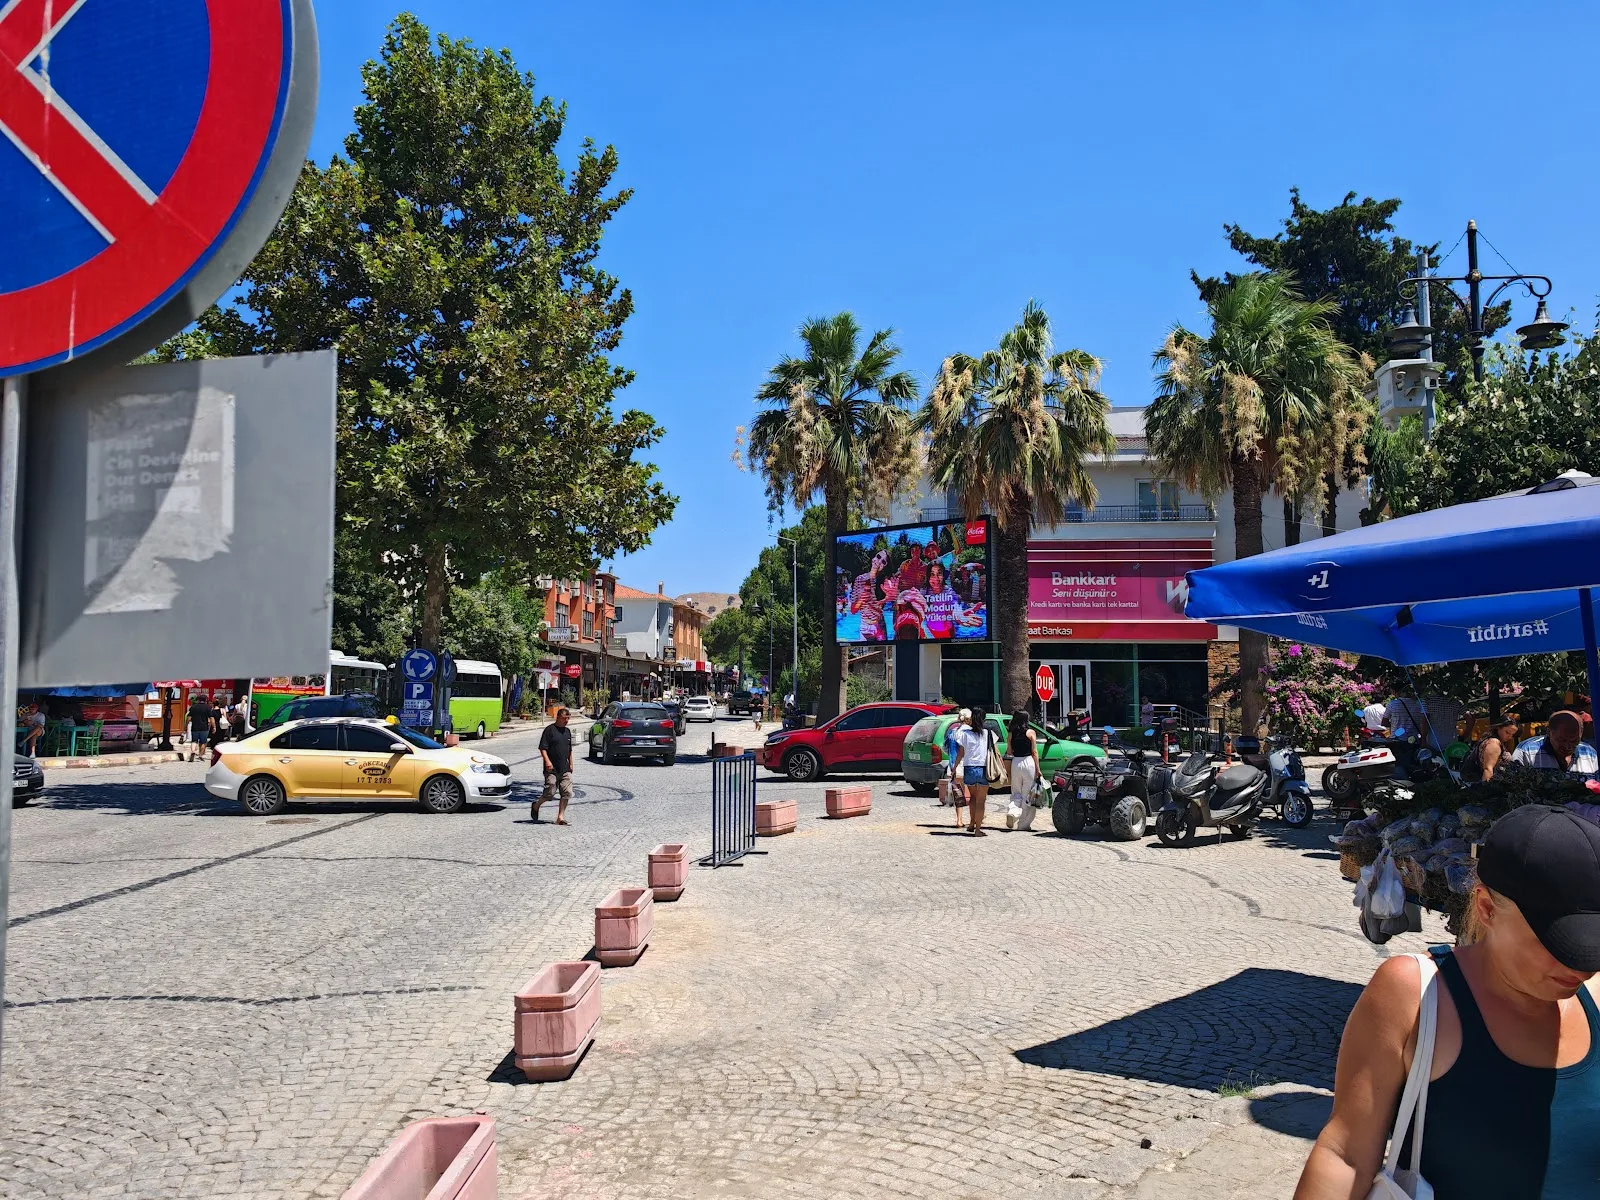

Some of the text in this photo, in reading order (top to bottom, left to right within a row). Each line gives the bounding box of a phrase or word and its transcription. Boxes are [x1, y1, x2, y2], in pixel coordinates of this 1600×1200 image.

[104, 473, 135, 488] Dur
[1051, 571, 1117, 586] Bankkart
[1307, 569, 1330, 589] +1
[925, 593, 953, 603] Tatilin
[1052, 588, 1117, 600] Seni düşünür o
[1030, 600, 1047, 608] Kredi
[1071, 600, 1091, 608] banka
[1107, 600, 1118, 608] tek
[1042, 626, 1073, 636] Bankası
[1037, 675, 1053, 691] DUR
[412, 683, 425, 699] P
[367, 776, 372, 784] T
